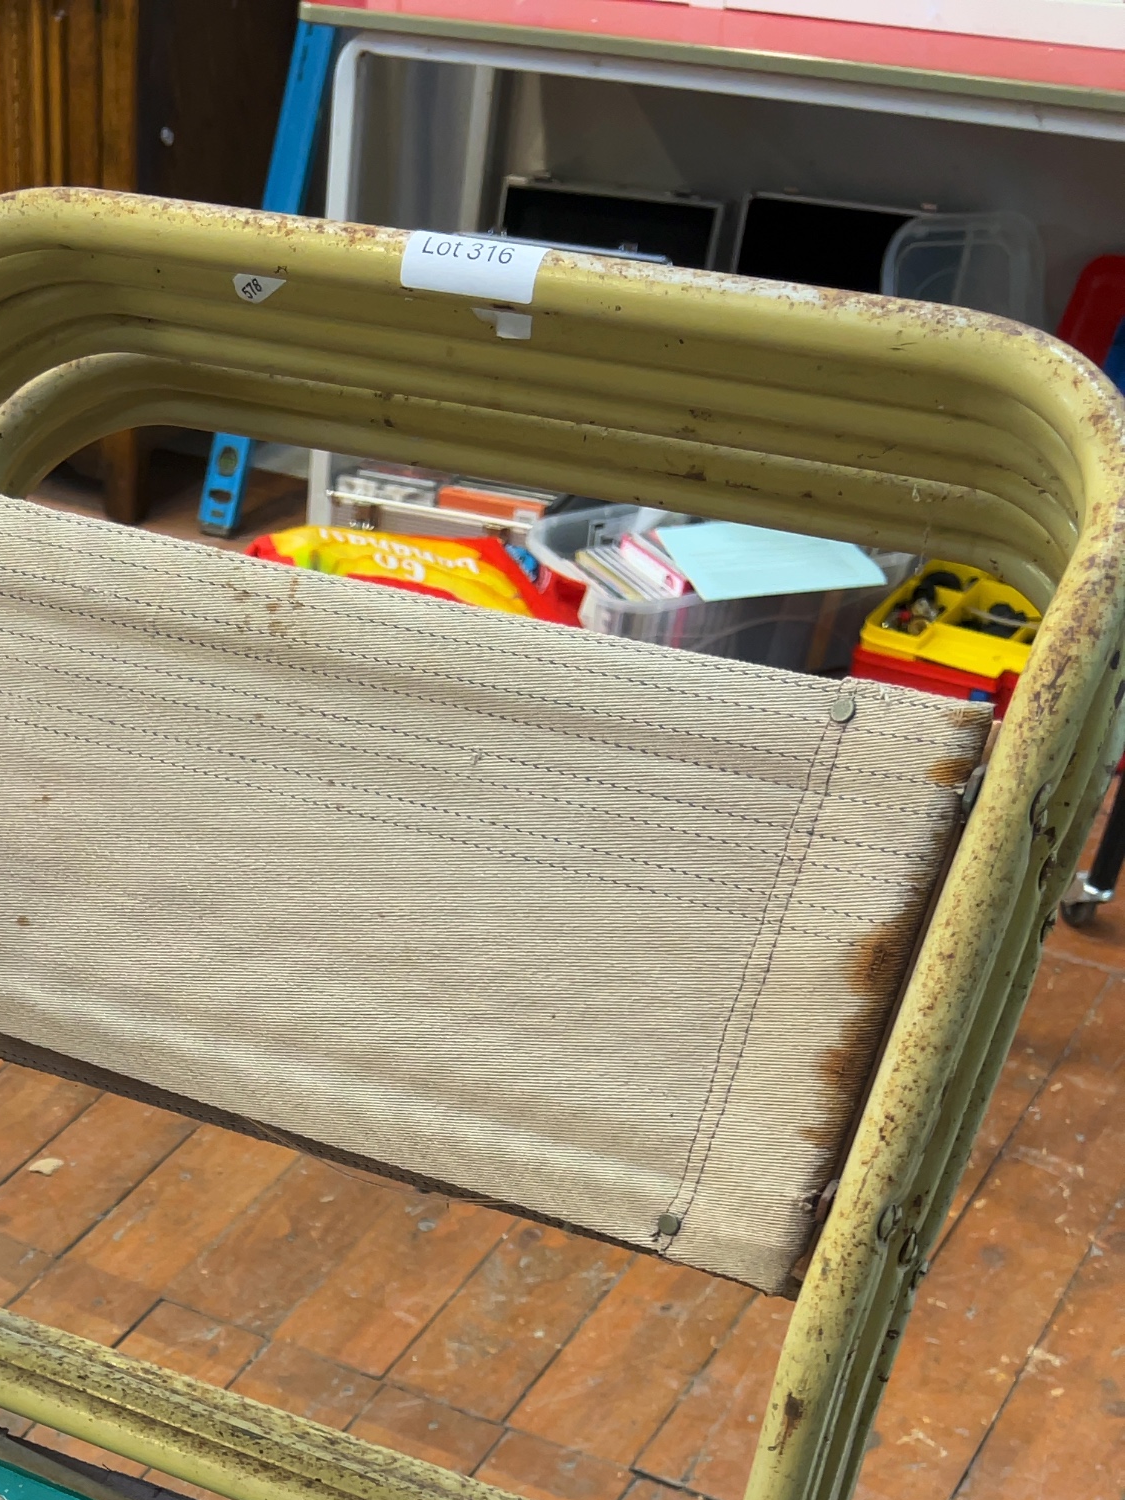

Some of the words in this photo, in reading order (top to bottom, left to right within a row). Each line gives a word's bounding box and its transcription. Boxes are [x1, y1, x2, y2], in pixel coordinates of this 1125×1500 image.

[422, 236, 463, 258] Lot
[466, 242, 515, 264] 316
[241, 278, 262, 299] 578
